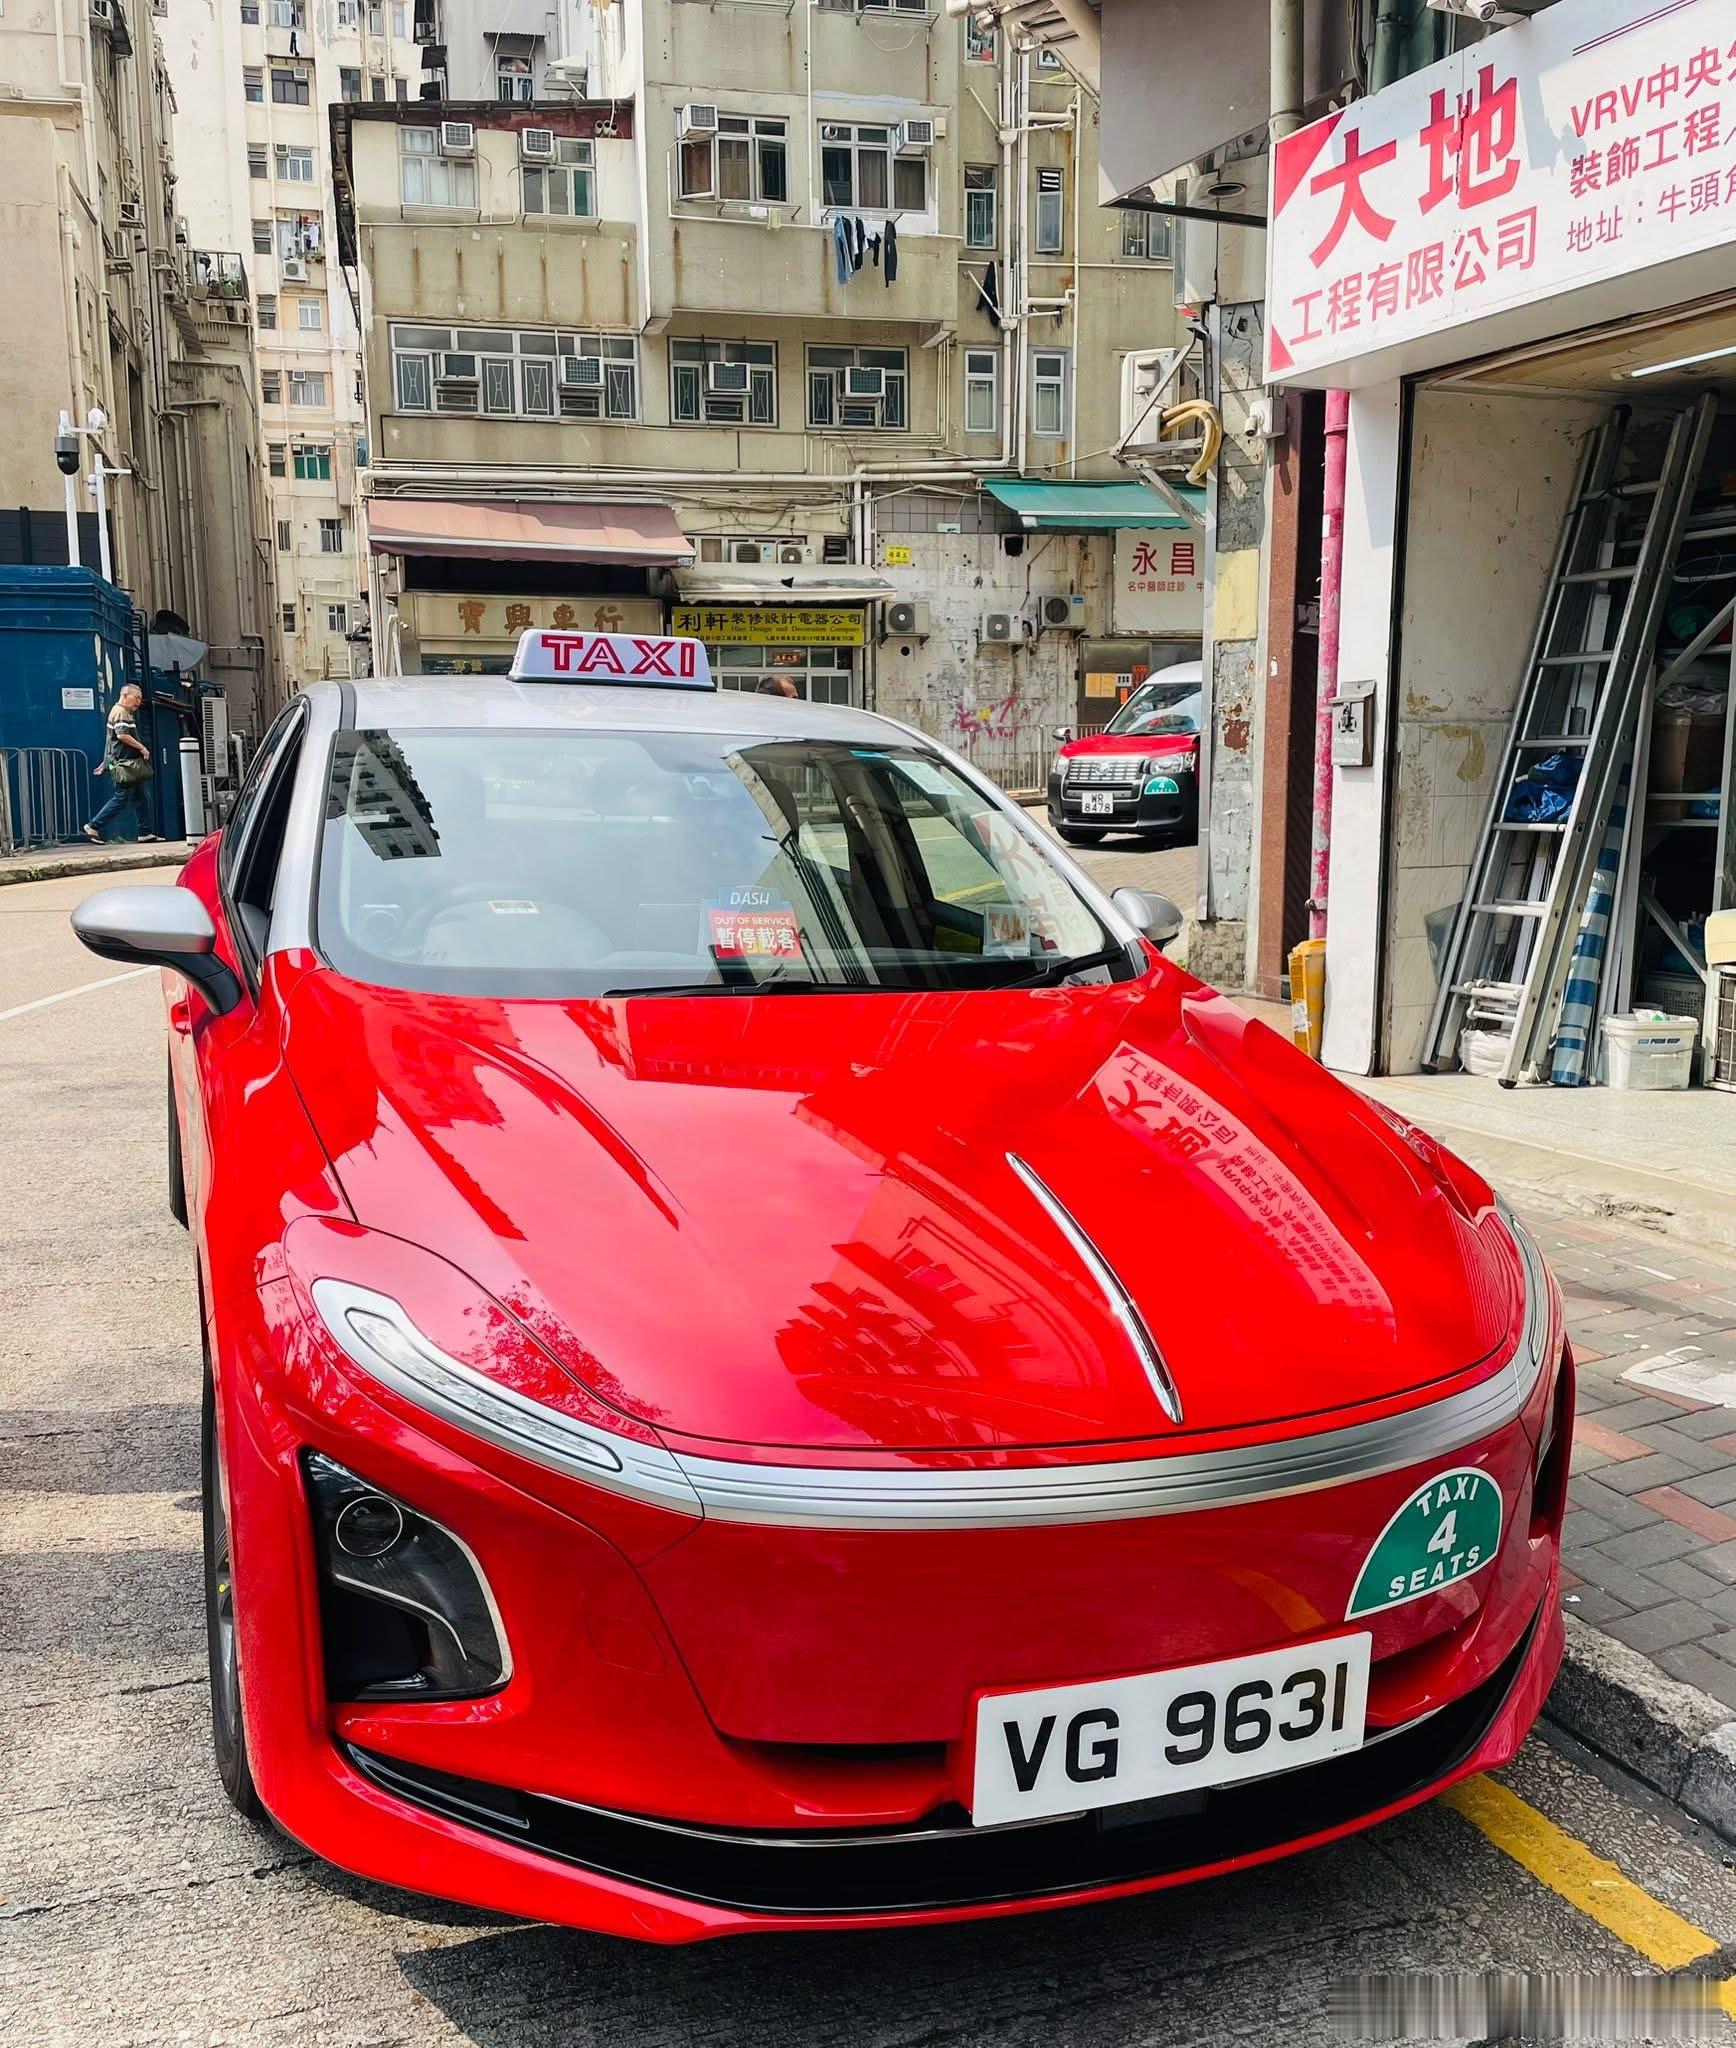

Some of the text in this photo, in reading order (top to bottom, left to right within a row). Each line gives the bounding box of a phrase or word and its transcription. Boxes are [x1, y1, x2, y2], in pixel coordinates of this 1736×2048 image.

[1309, 63, 1520, 270] 大地
[1289, 206, 1538, 347] 工程有限公司
[1132, 541, 1195, 576] 永昌
[541, 634, 696, 678] TAXI
[1084, 803, 1111, 813] 8478
[1092, 793, 1104, 803] WR
[730, 892, 770, 905] DASH
[714, 917, 793, 926] OUT OF SERVICE
[716, 927, 796, 949] 暫停載客
[1416, 1476, 1480, 1517] TAXI
[1427, 1509, 1457, 1555] 4
[1388, 1545, 1480, 1598] SEATS
[1003, 1662, 1349, 1792] VG 9631
